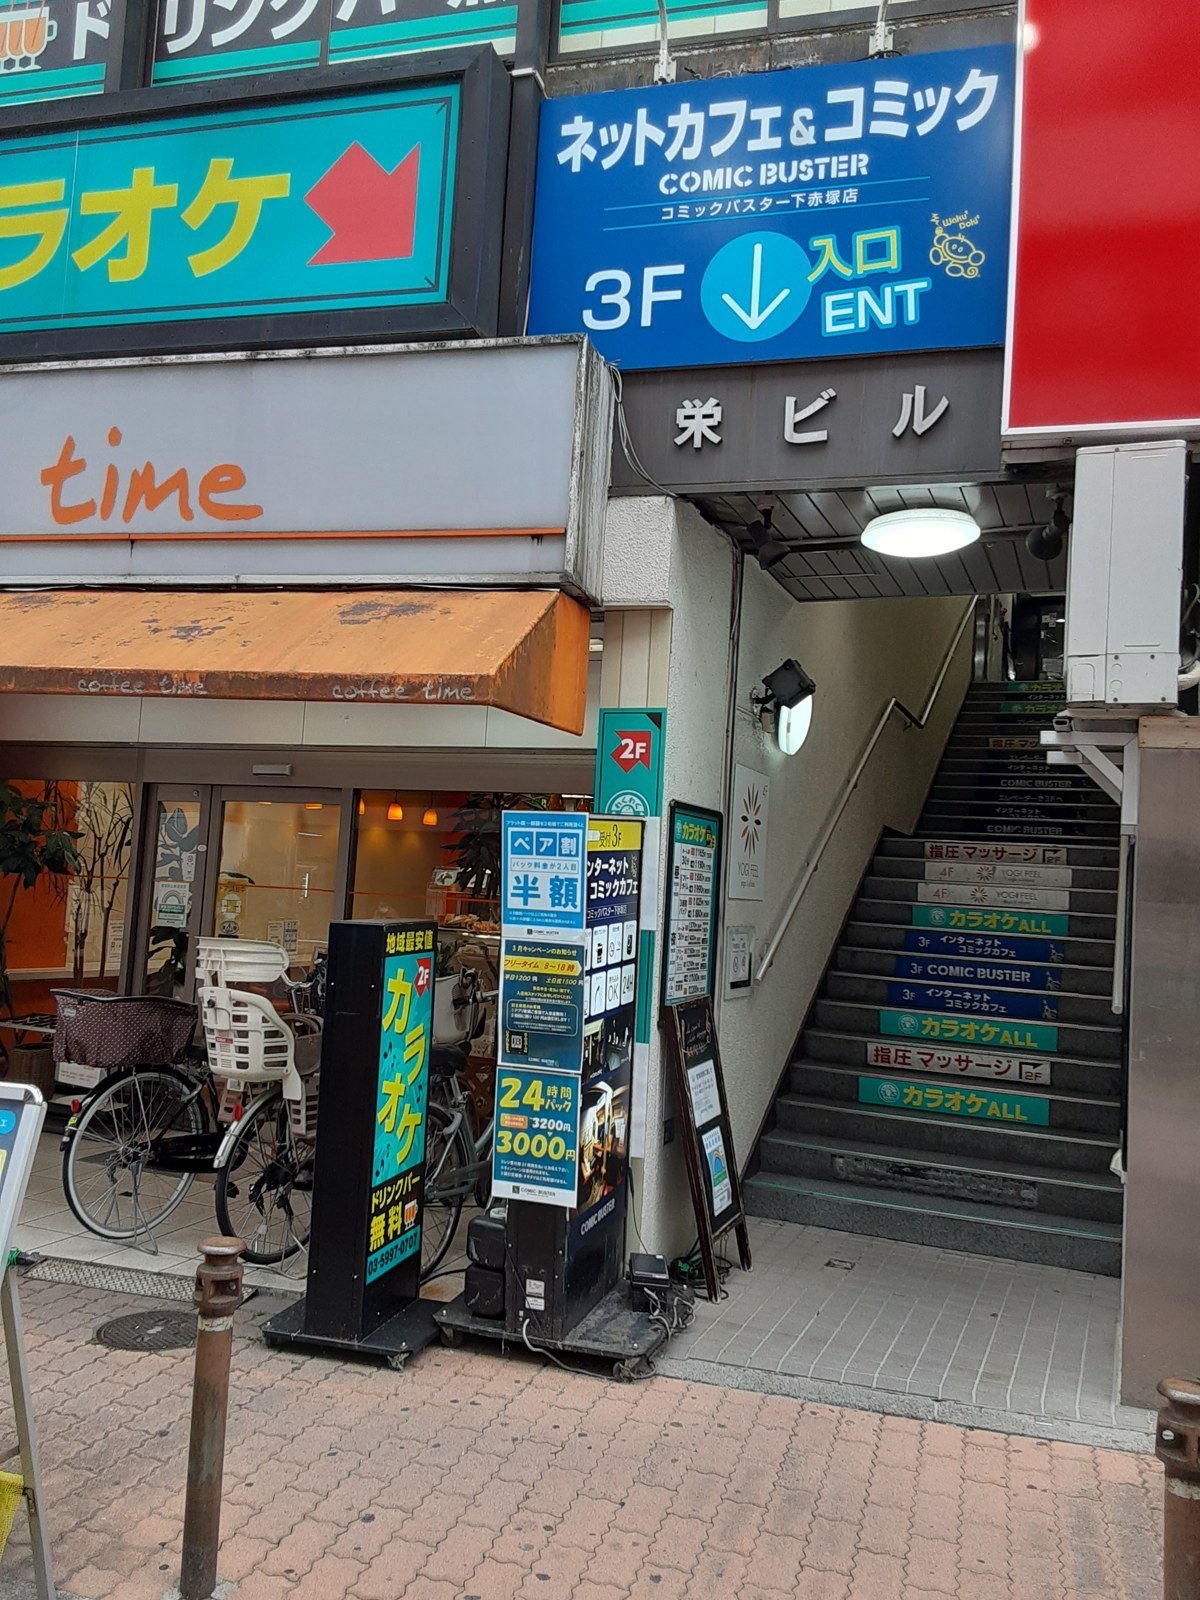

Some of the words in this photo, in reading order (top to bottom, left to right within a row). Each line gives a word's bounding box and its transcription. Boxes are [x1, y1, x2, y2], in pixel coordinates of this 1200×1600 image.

[658, 163, 753, 195] COMIC
[759, 153, 869, 186] BUSTER
[661, 188, 859, 220] コミックバスター下赤塚店
[808, 229, 898, 282] 入口
[582, 264, 686, 331] 3F
[825, 281, 928, 333] ENT
[674, 384, 949, 448] 栄ビル
[41, 426, 264, 524] time
[78, 671, 145, 693] coffee
[159, 675, 207, 695] time
[332, 677, 409, 700] coffee
[423, 678, 475, 700] time
[619, 738, 647, 759] 2F
[1000, 779, 1034, 788] COMIC
[1035, 780, 1072, 788] BUSTER
[1022, 826, 1064, 835] BUSTER
[513, 836, 577, 856] ペア割
[940, 867, 954, 877] 4F
[510, 873, 579, 910] 半額
[590, 877, 638, 900] コミックカフェ
[933, 888, 948, 899] 4F
[386, 929, 434, 954] 地域最安値
[918, 936, 930, 948] 3F
[940, 935, 1001, 947] インターネット
[959, 944, 1017, 958] コミックカフェ
[504, 959, 539, 969] フリータイム
[910, 963, 922, 975] 3F
[927, 963, 975, 978] COMIC
[977, 967, 1031, 983] BUSTER
[417, 966, 430, 988] 2F
[607, 983, 619, 1002] OK
[902, 989, 915, 1001] 3F
[925, 988, 991, 1002] インターネット
[945, 999, 1007, 1013] コミックカフェ
[377, 968, 426, 1165] カラオケ
[873, 1046, 1012, 1076] 指圧マッサージ
[1025, 1072, 1043, 1081] 2F
[499, 1077, 545, 1112] 24
[545, 1098, 572, 1113] パック
[532, 1117, 571, 1132] 3200円
[496, 1130, 576, 1162] 3000円
[371, 1173, 421, 1214] ドリンクバー
[369, 1200, 403, 1254] 無料
[367, 1234, 418, 1278] 03-5997-0707
